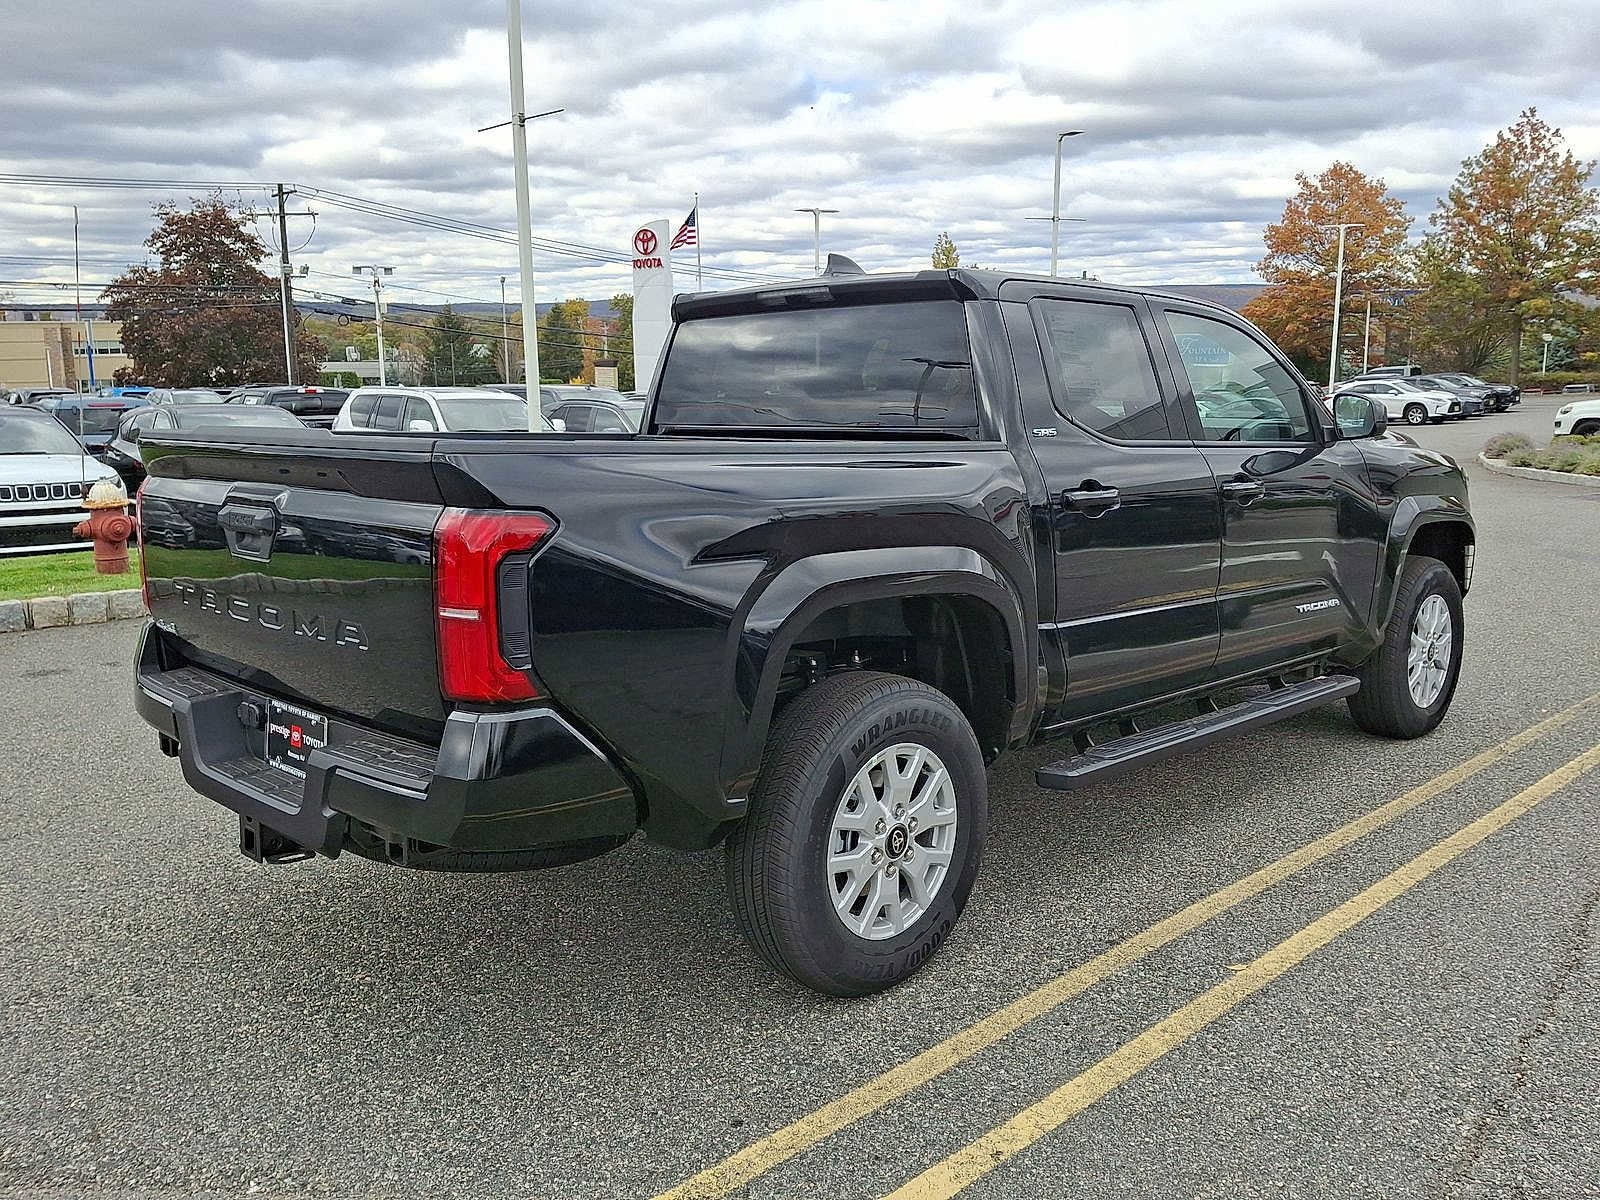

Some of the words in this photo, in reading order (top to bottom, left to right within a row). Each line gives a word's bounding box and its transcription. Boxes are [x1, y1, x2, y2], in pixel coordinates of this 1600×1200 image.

[632, 258, 663, 269] TOYOTA
[1032, 427, 1057, 438] SR5
[172, 577, 369, 650] TACOMA
[1295, 598, 1340, 613] TACOMA
[270, 723, 290, 739] prestige
[303, 734, 324, 748] TOYOTA
[850, 707, 952, 759] WRANGLER
